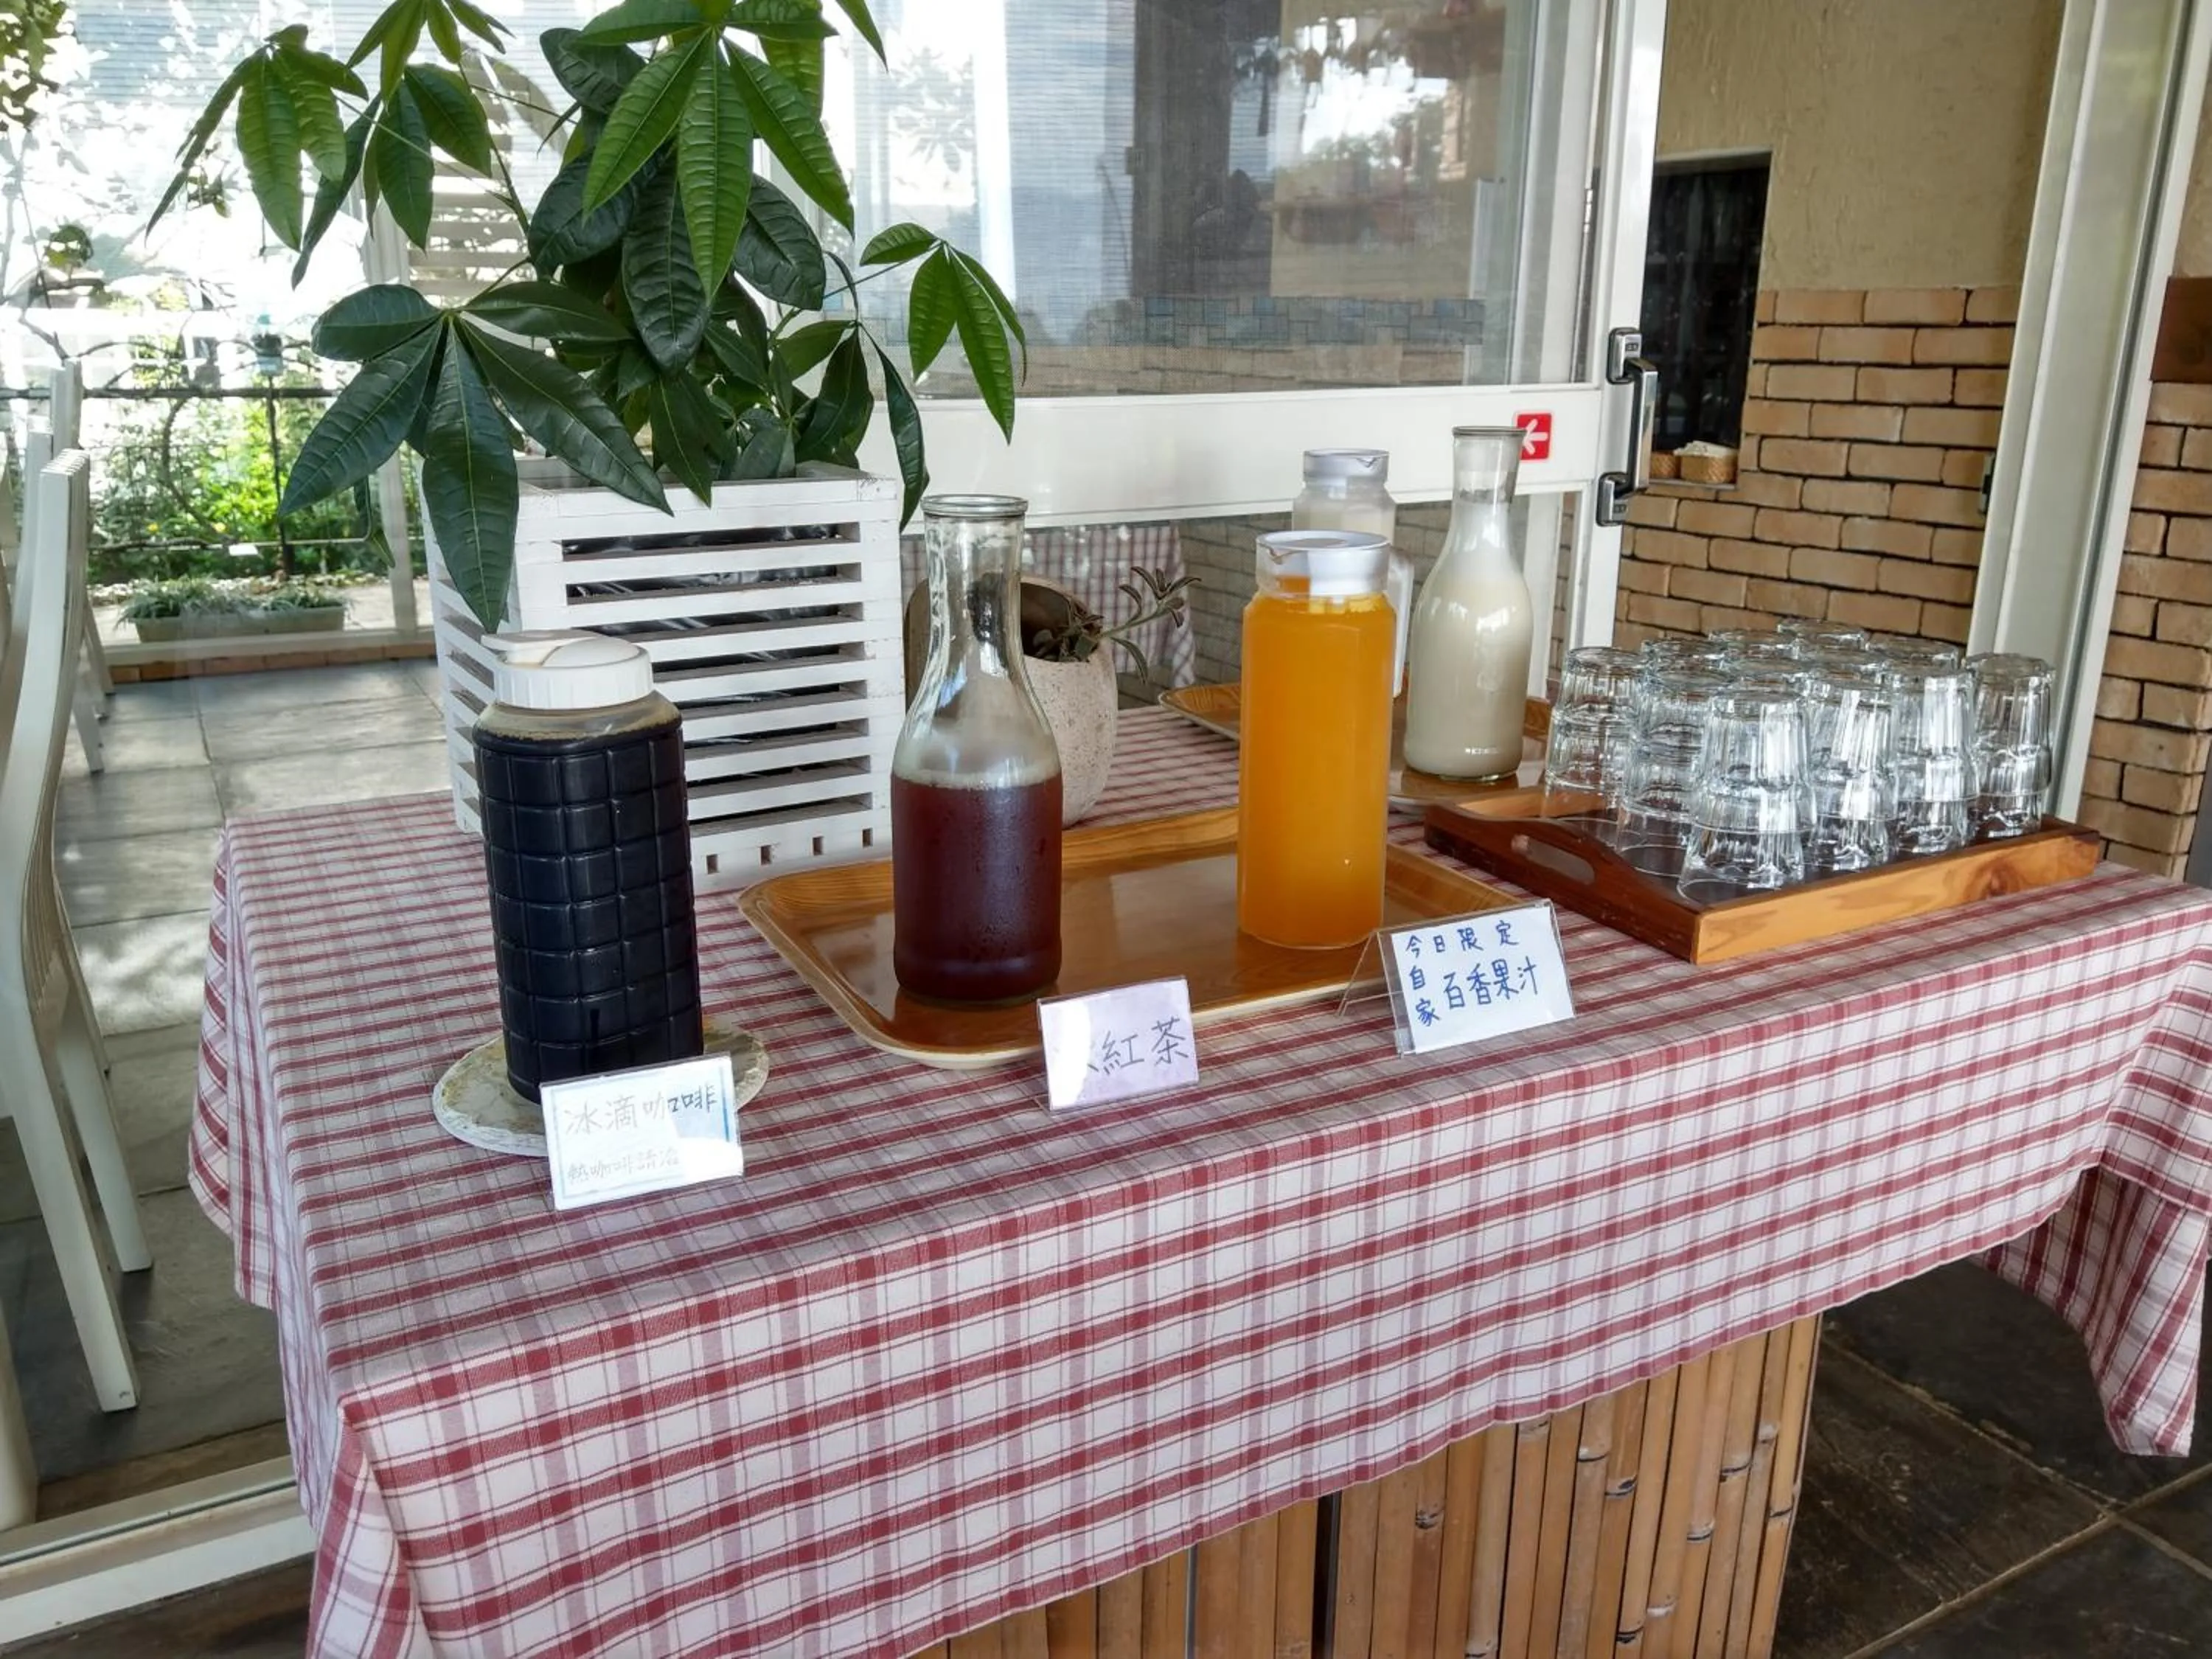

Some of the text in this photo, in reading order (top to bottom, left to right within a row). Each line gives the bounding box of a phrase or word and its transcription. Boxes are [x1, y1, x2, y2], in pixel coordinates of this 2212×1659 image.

[1405, 919, 1520, 959] 今日限定
[1443, 956, 1538, 1009] 百香果汁
[1087, 1016, 1189, 1075] 紅茶
[563, 1084, 718, 1136] 冰滴咖啡
